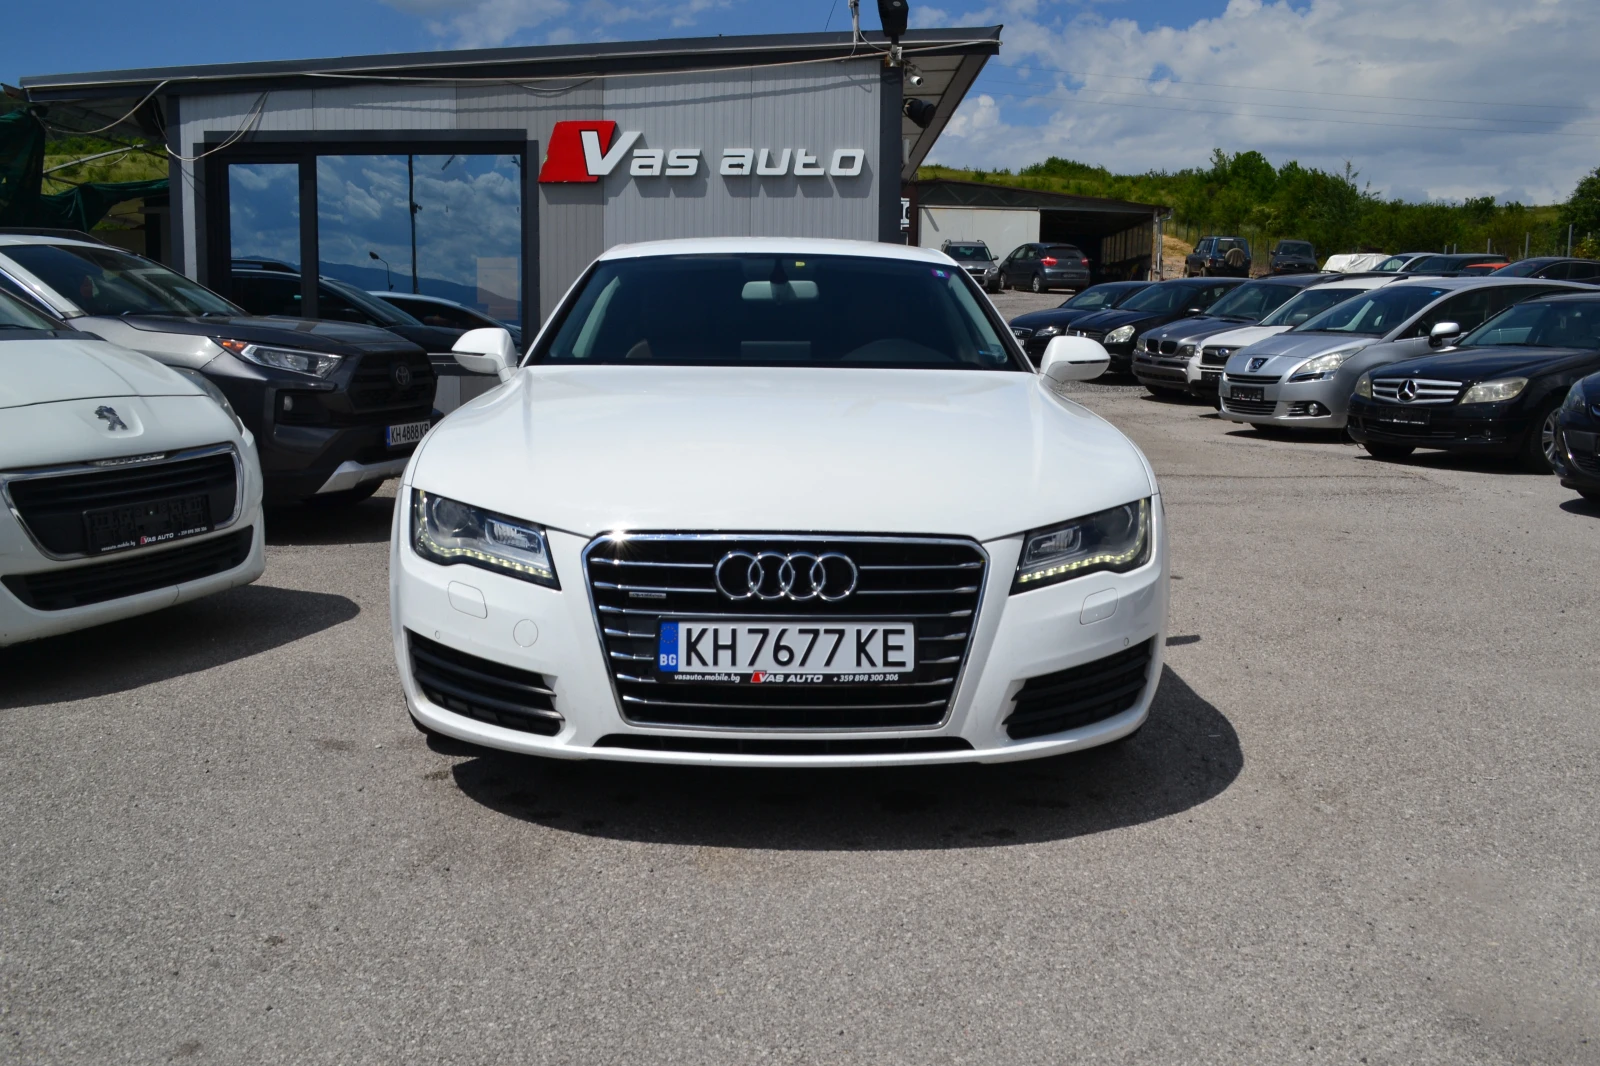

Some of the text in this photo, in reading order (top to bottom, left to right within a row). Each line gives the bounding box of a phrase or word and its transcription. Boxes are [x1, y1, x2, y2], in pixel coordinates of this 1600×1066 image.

[580, 130, 865, 176] Vas auto
[157, 533, 174, 541] AUTO
[660, 654, 677, 666] BG
[674, 673, 740, 683] vasauto.mobile.bg
[759, 673, 784, 683] VAS
[787, 674, 823, 683] AUTO
[854, 674, 869, 682] 898
[869, 674, 884, 682] 300
[884, 673, 899, 681] 306
